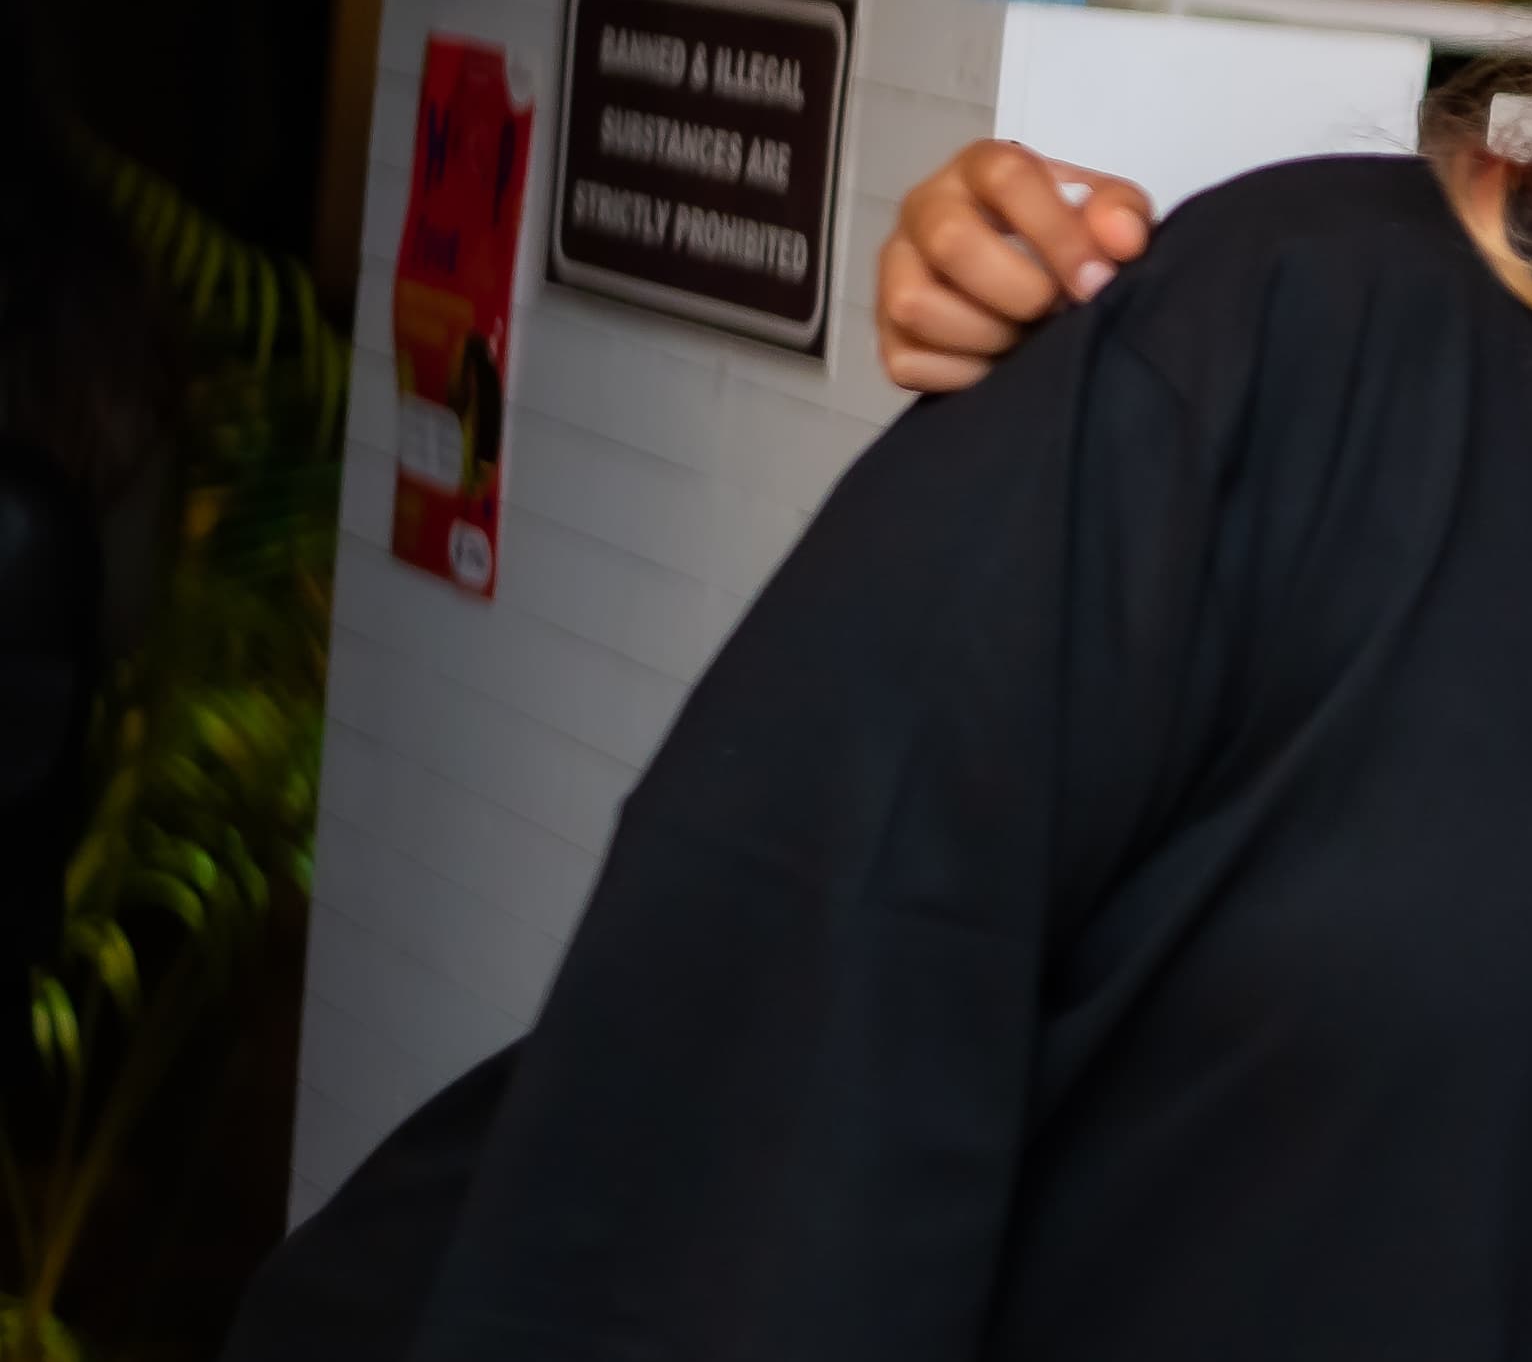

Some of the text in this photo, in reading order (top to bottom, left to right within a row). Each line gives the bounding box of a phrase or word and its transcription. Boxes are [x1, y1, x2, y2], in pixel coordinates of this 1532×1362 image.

[600, 24, 687, 88] BANNED
[713, 46, 805, 112] ILLEGAL
[600, 105, 792, 195] SUBSTANCES ARE
[572, 179, 809, 283] STRICTLY PROHIBITED
